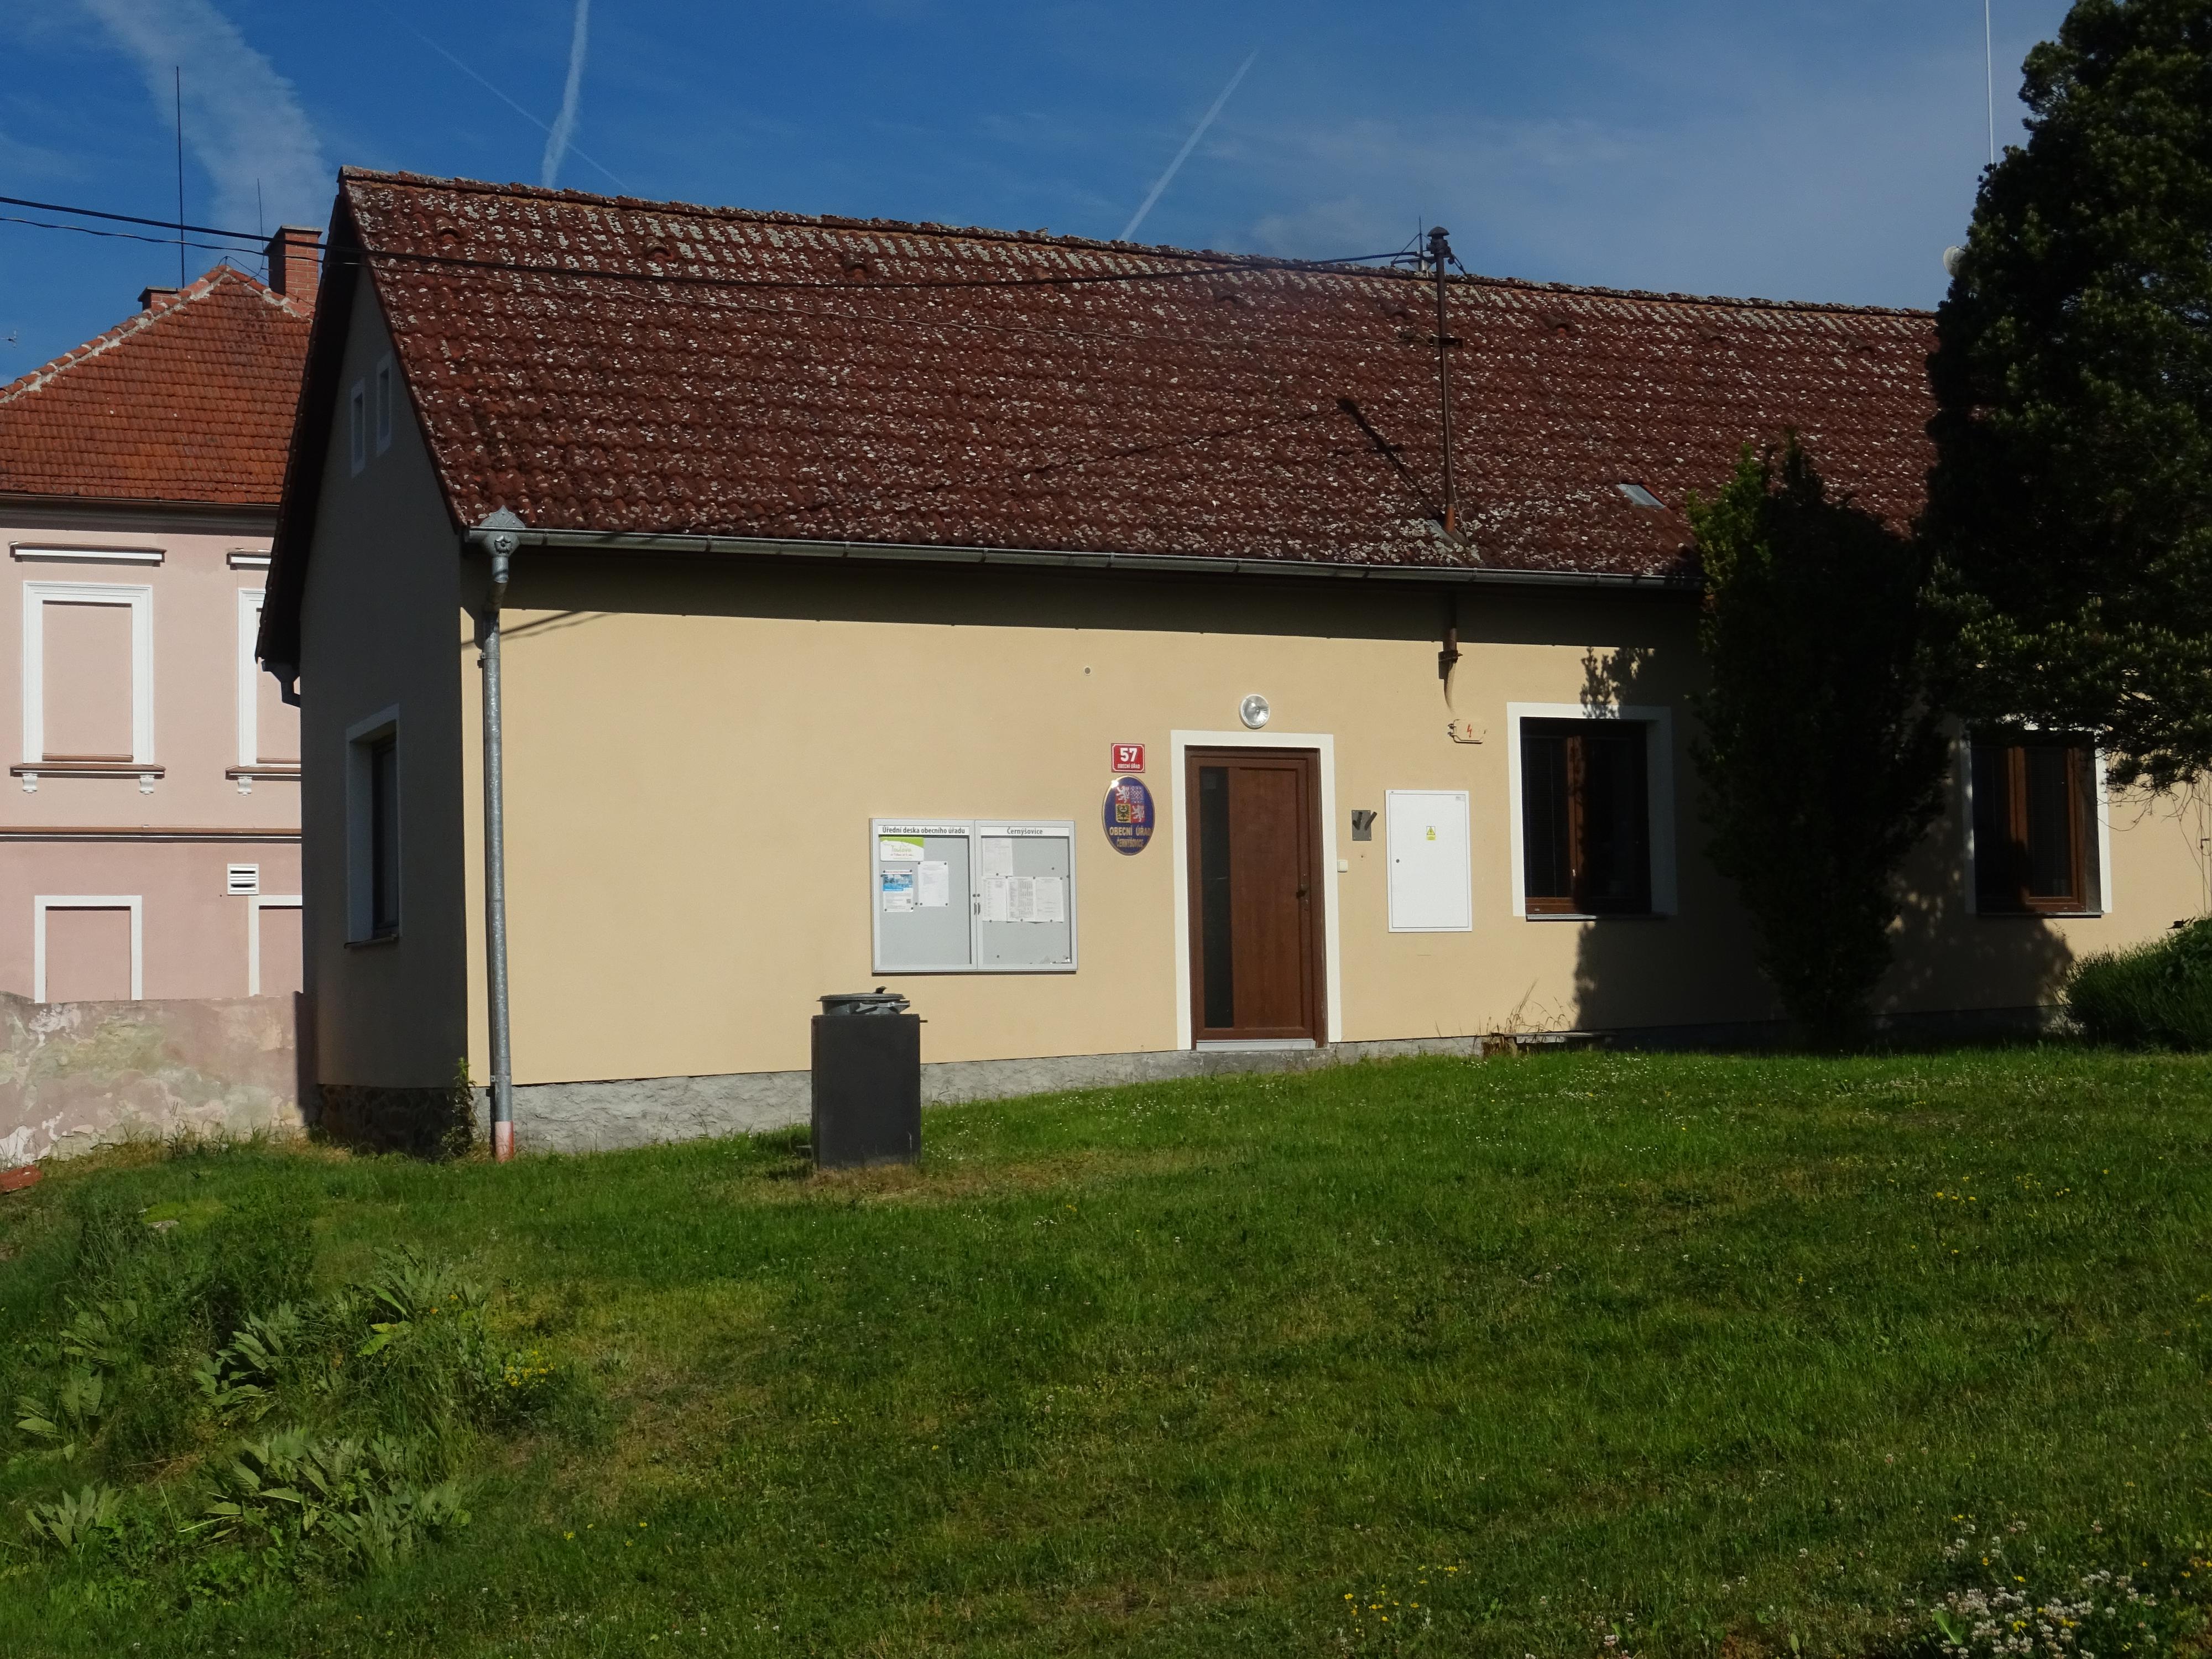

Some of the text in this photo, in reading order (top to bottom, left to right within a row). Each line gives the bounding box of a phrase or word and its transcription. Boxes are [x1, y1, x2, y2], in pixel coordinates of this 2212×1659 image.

[1120, 748, 1137, 762] 57
[1006, 827, 1043, 836] Černýšovice
[1109, 825, 1152, 836] OBECNÍ ÚŘAD
